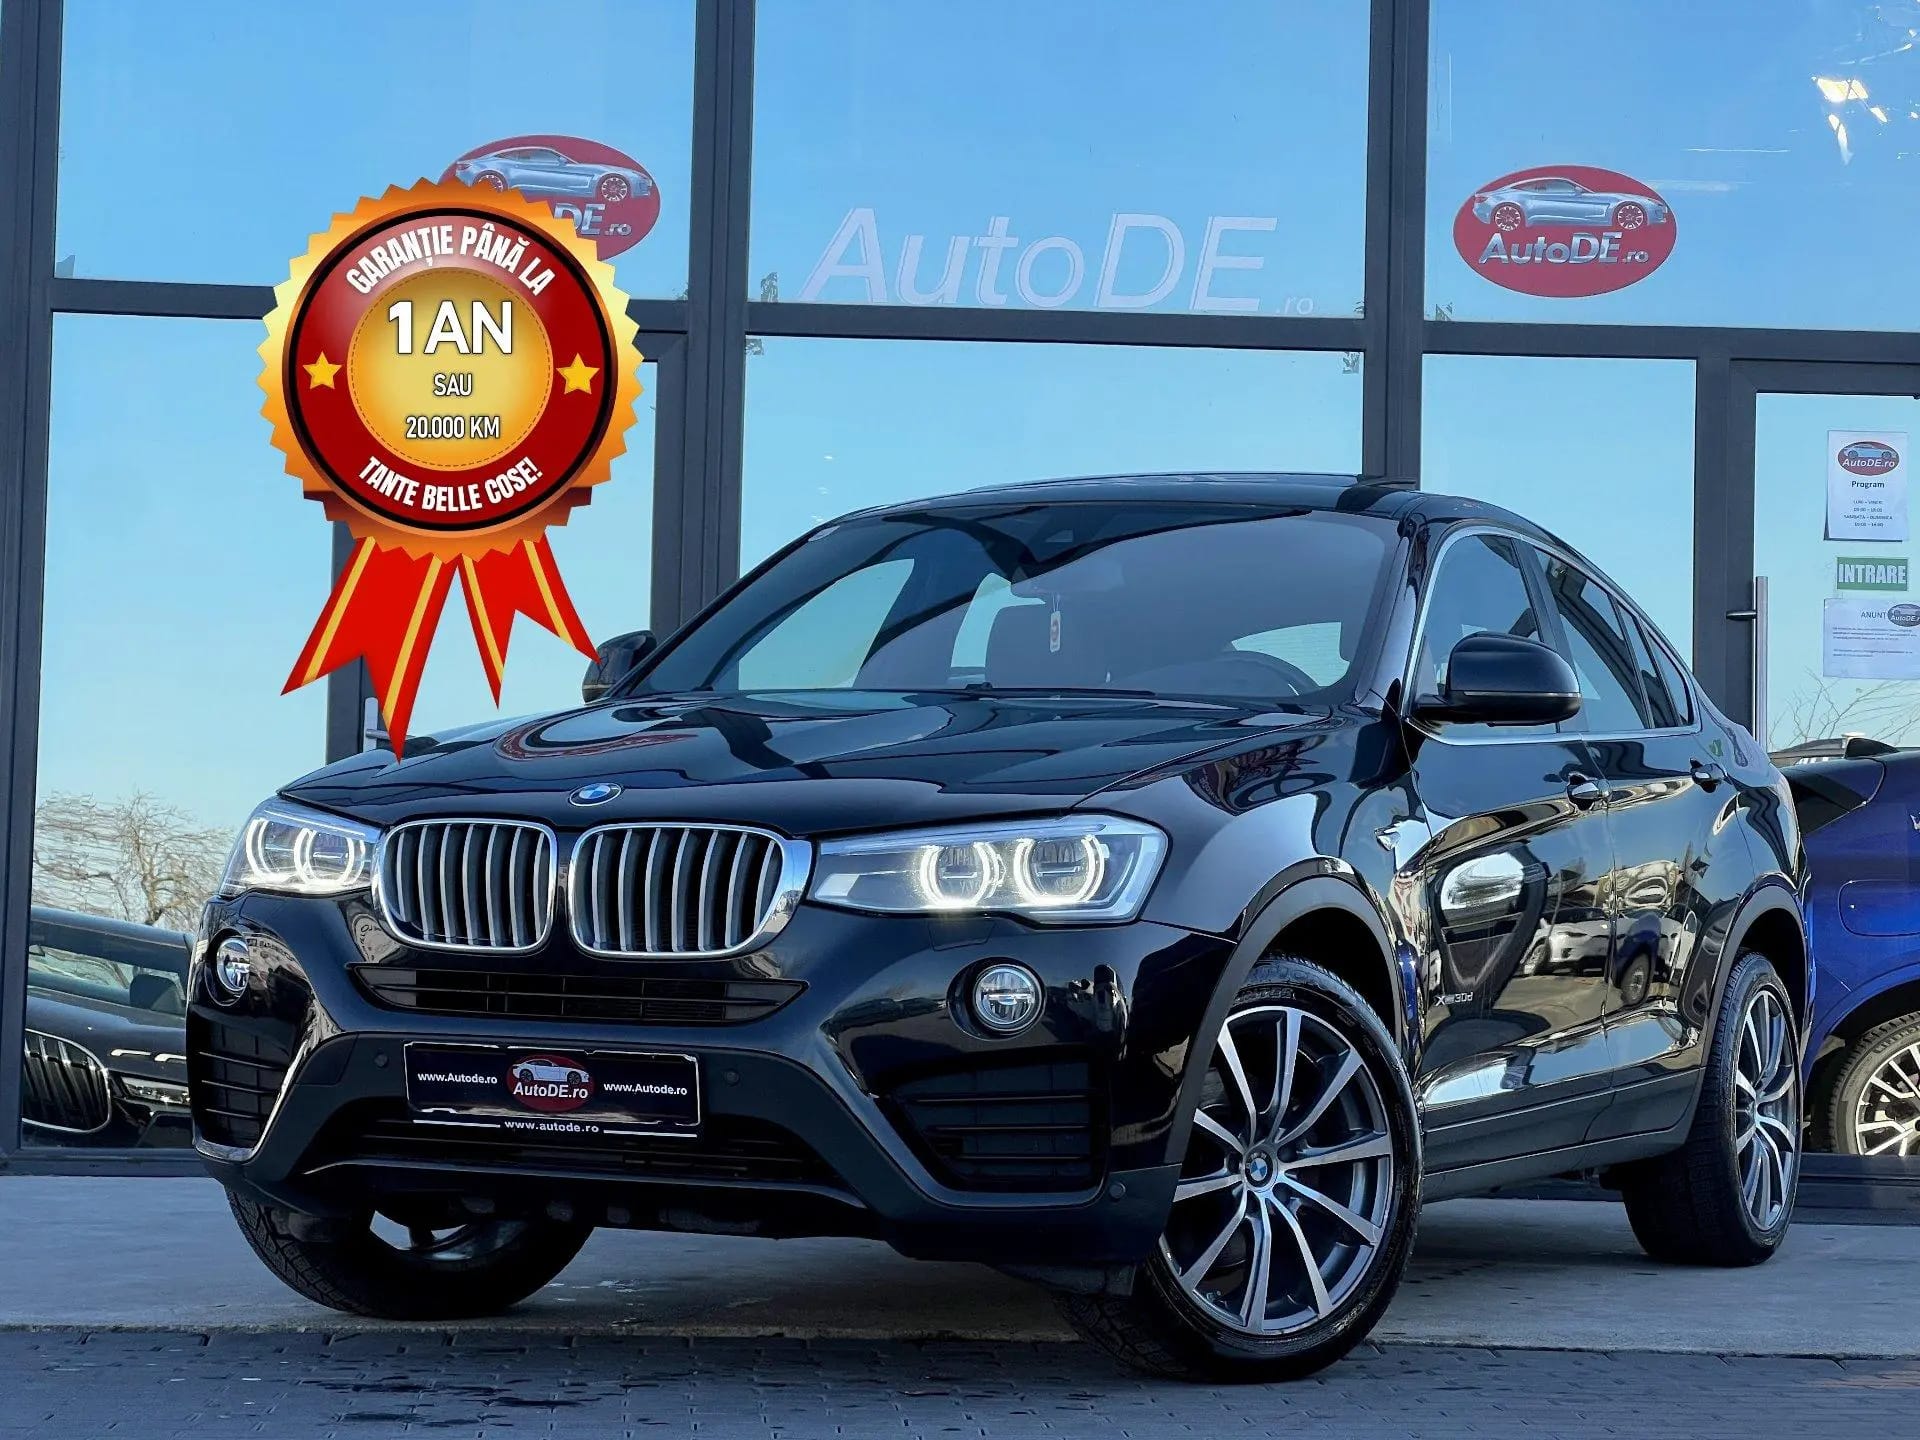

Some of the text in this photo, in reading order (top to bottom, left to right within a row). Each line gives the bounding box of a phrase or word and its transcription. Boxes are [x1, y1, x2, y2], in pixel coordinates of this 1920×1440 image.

[1841, 458, 1896, 469] AutoDE.ro
[1851, 480, 1885, 490] Program
[1838, 563, 1907, 584] INTRARE
[417, 1072, 498, 1085] www.Autode.ro
[513, 1081, 589, 1099] AutoDE.ro
[603, 1083, 688, 1096] www.Autode.ro
[504, 1120, 599, 1133] www.autode.ro
